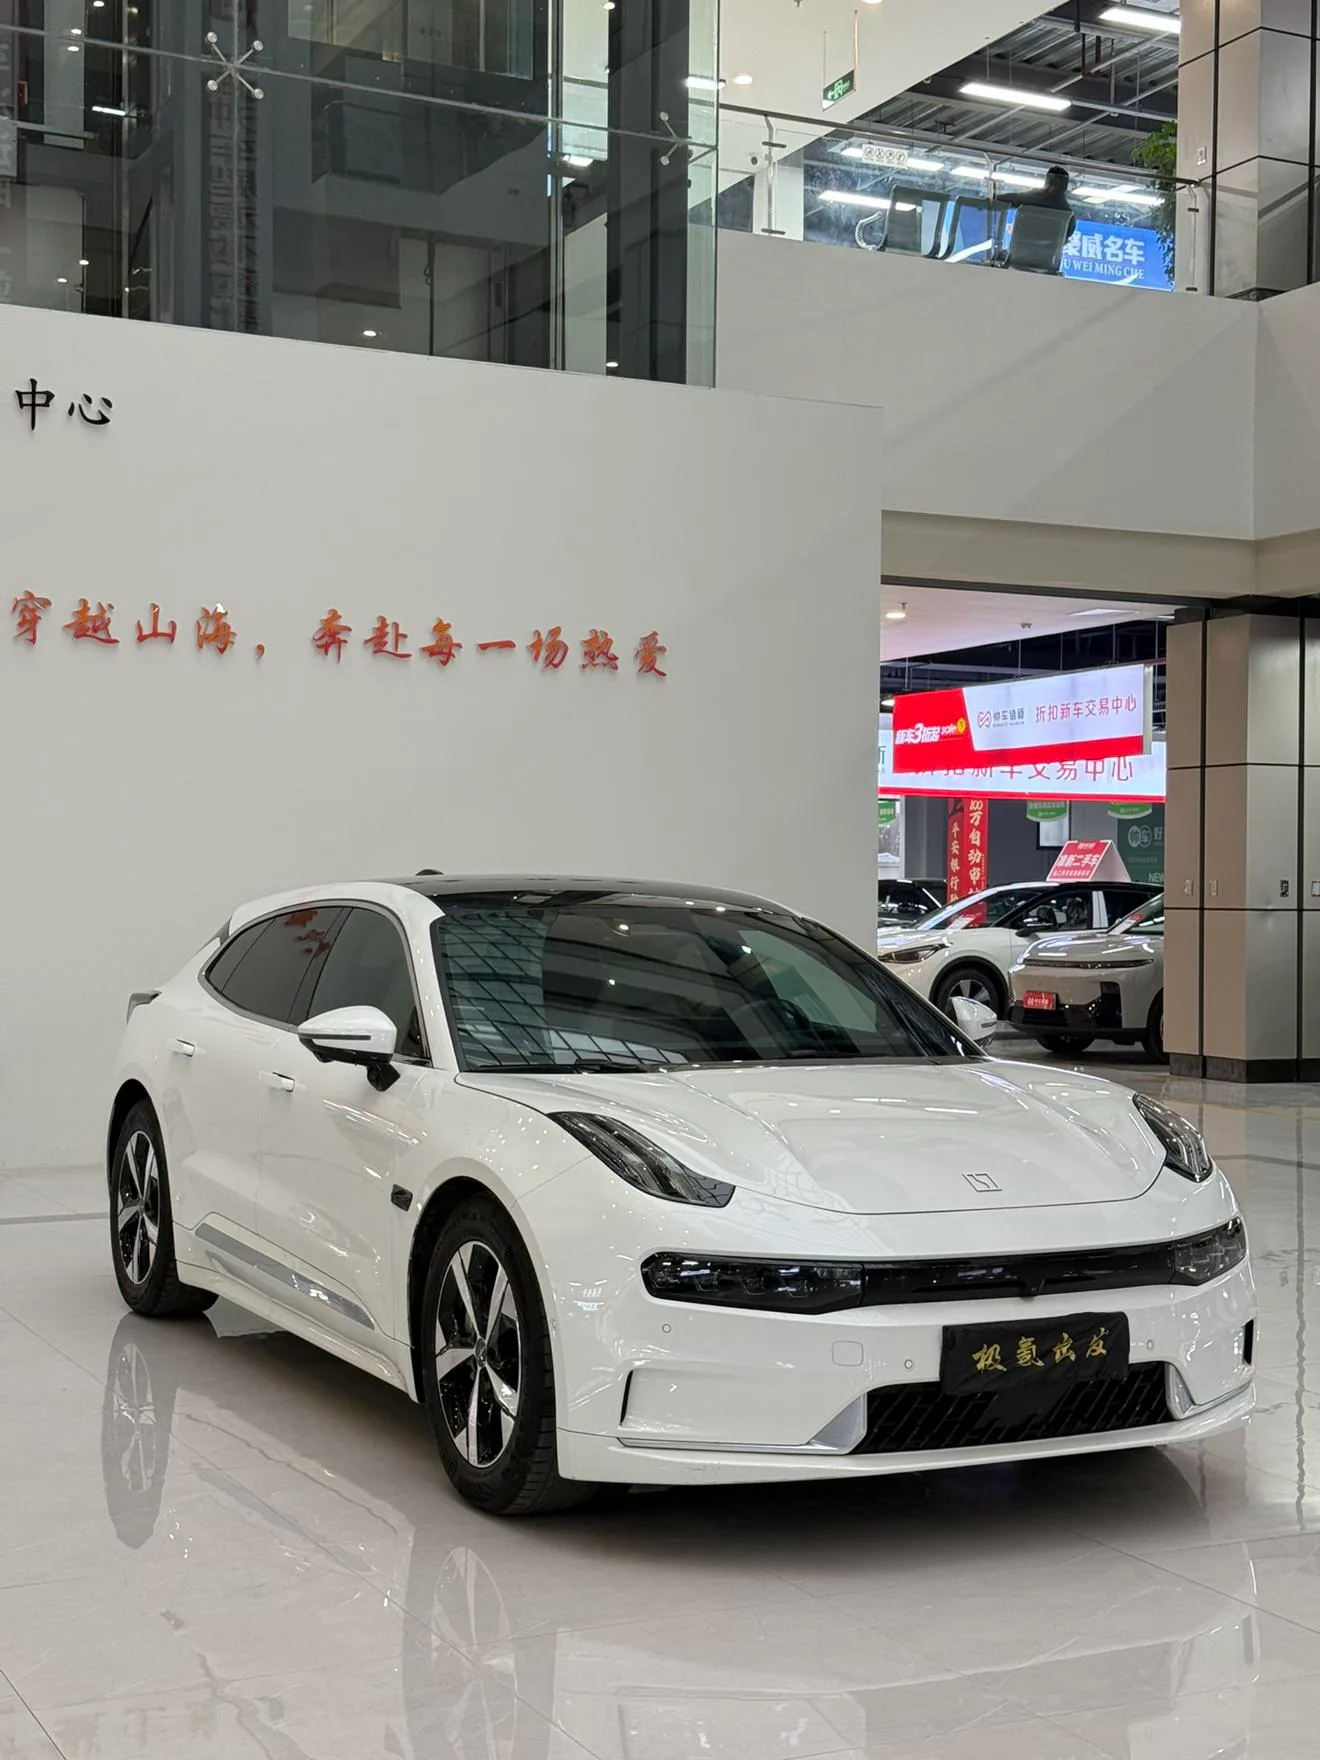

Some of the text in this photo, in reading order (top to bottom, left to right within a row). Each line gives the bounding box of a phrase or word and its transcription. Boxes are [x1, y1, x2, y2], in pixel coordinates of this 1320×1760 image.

[1073, 259, 1093, 272] WEI
[1094, 262, 1123, 277] MING
[1123, 267, 1145, 280] CHE
[15, 378, 113, 430] 中心
[1035, 694, 1137, 723] 折扣新车交易中心
[968, 800, 982, 895] 100万自动审
[971, 1327, 1109, 1374] 极氪出发
